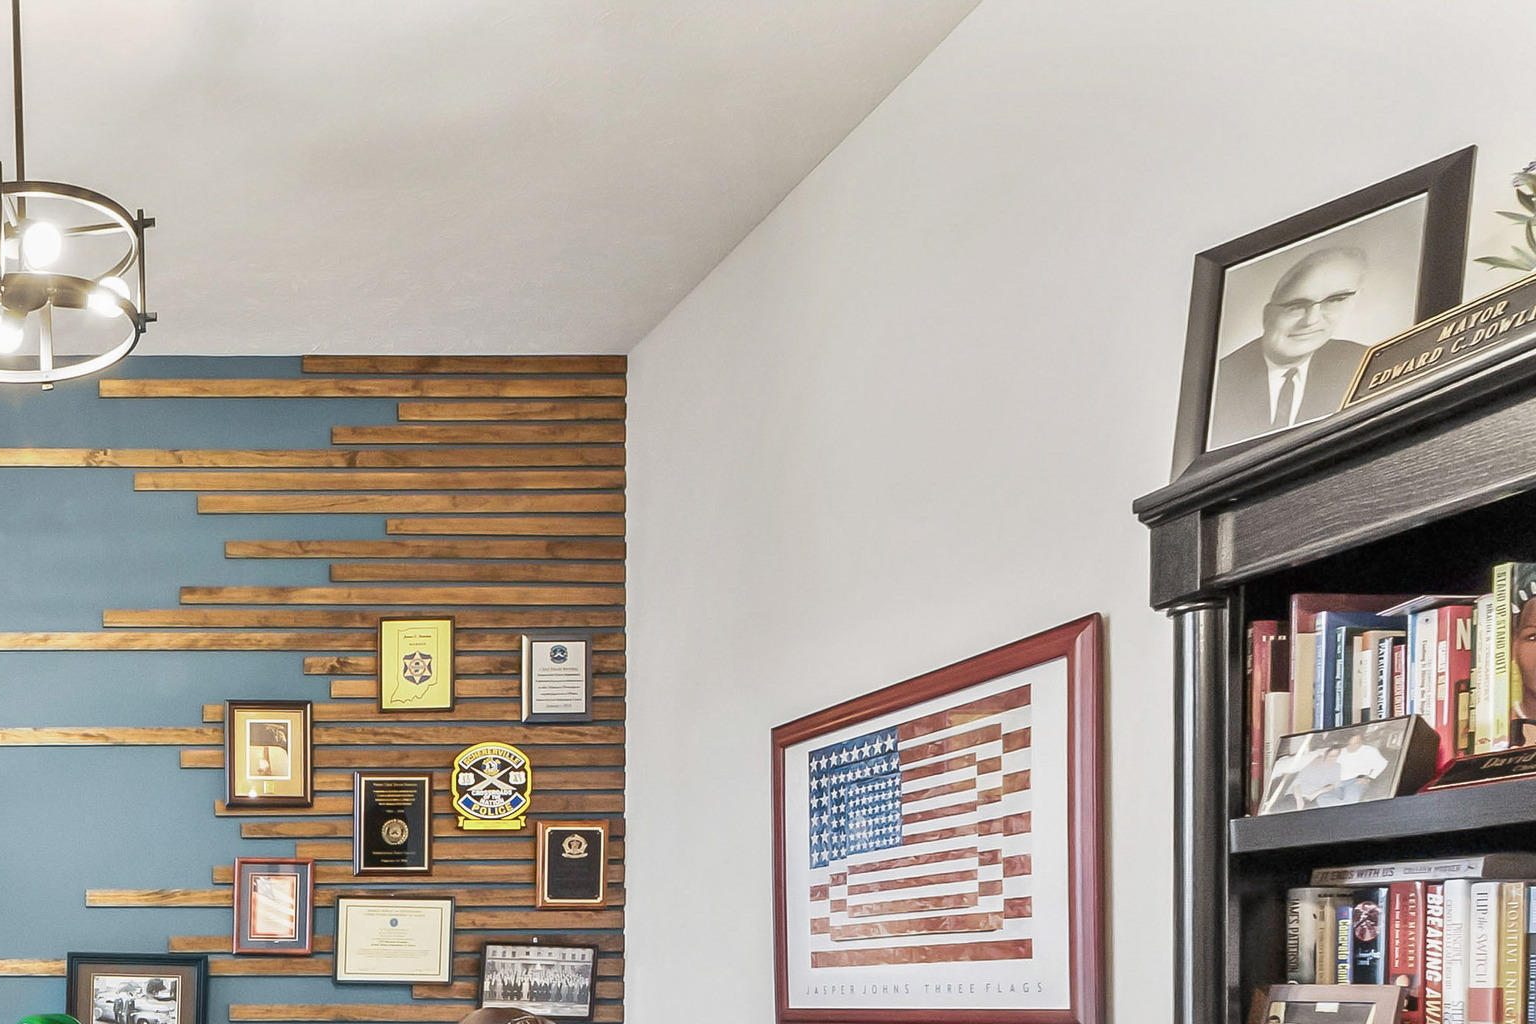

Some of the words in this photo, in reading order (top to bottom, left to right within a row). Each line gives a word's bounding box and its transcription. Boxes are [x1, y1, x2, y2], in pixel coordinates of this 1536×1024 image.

[1437, 300, 1508, 342] MAYOR
[1368, 347, 1443, 389] EDWARD
[1496, 571, 1506, 601] STAND
[1496, 604, 1506, 617] UP
[1496, 620, 1506, 649] STAND
[1495, 651, 1506, 675] OUT!
[471, 802, 514, 816] POLICE
[1356, 868, 1380, 878] WITH
[1382, 867, 1395, 877] US
[1287, 899, 1300, 924] JAMES
[1408, 893, 1416, 917] SELF
[1476, 892, 1488, 914] FLIP
[1408, 921, 1416, 968] MATTERS
[1426, 893, 1443, 983] BREAKING
[1506, 901, 1518, 964] POSITIVE
[1287, 927, 1300, 973] PATTERSON
[1475, 933, 1488, 983] SWITCH
[806, 985, 855, 996] JASPER
[863, 984, 910, 995] JOHNS
[924, 983, 975, 994] THREE
[985, 982, 1043, 993] FLAGS
